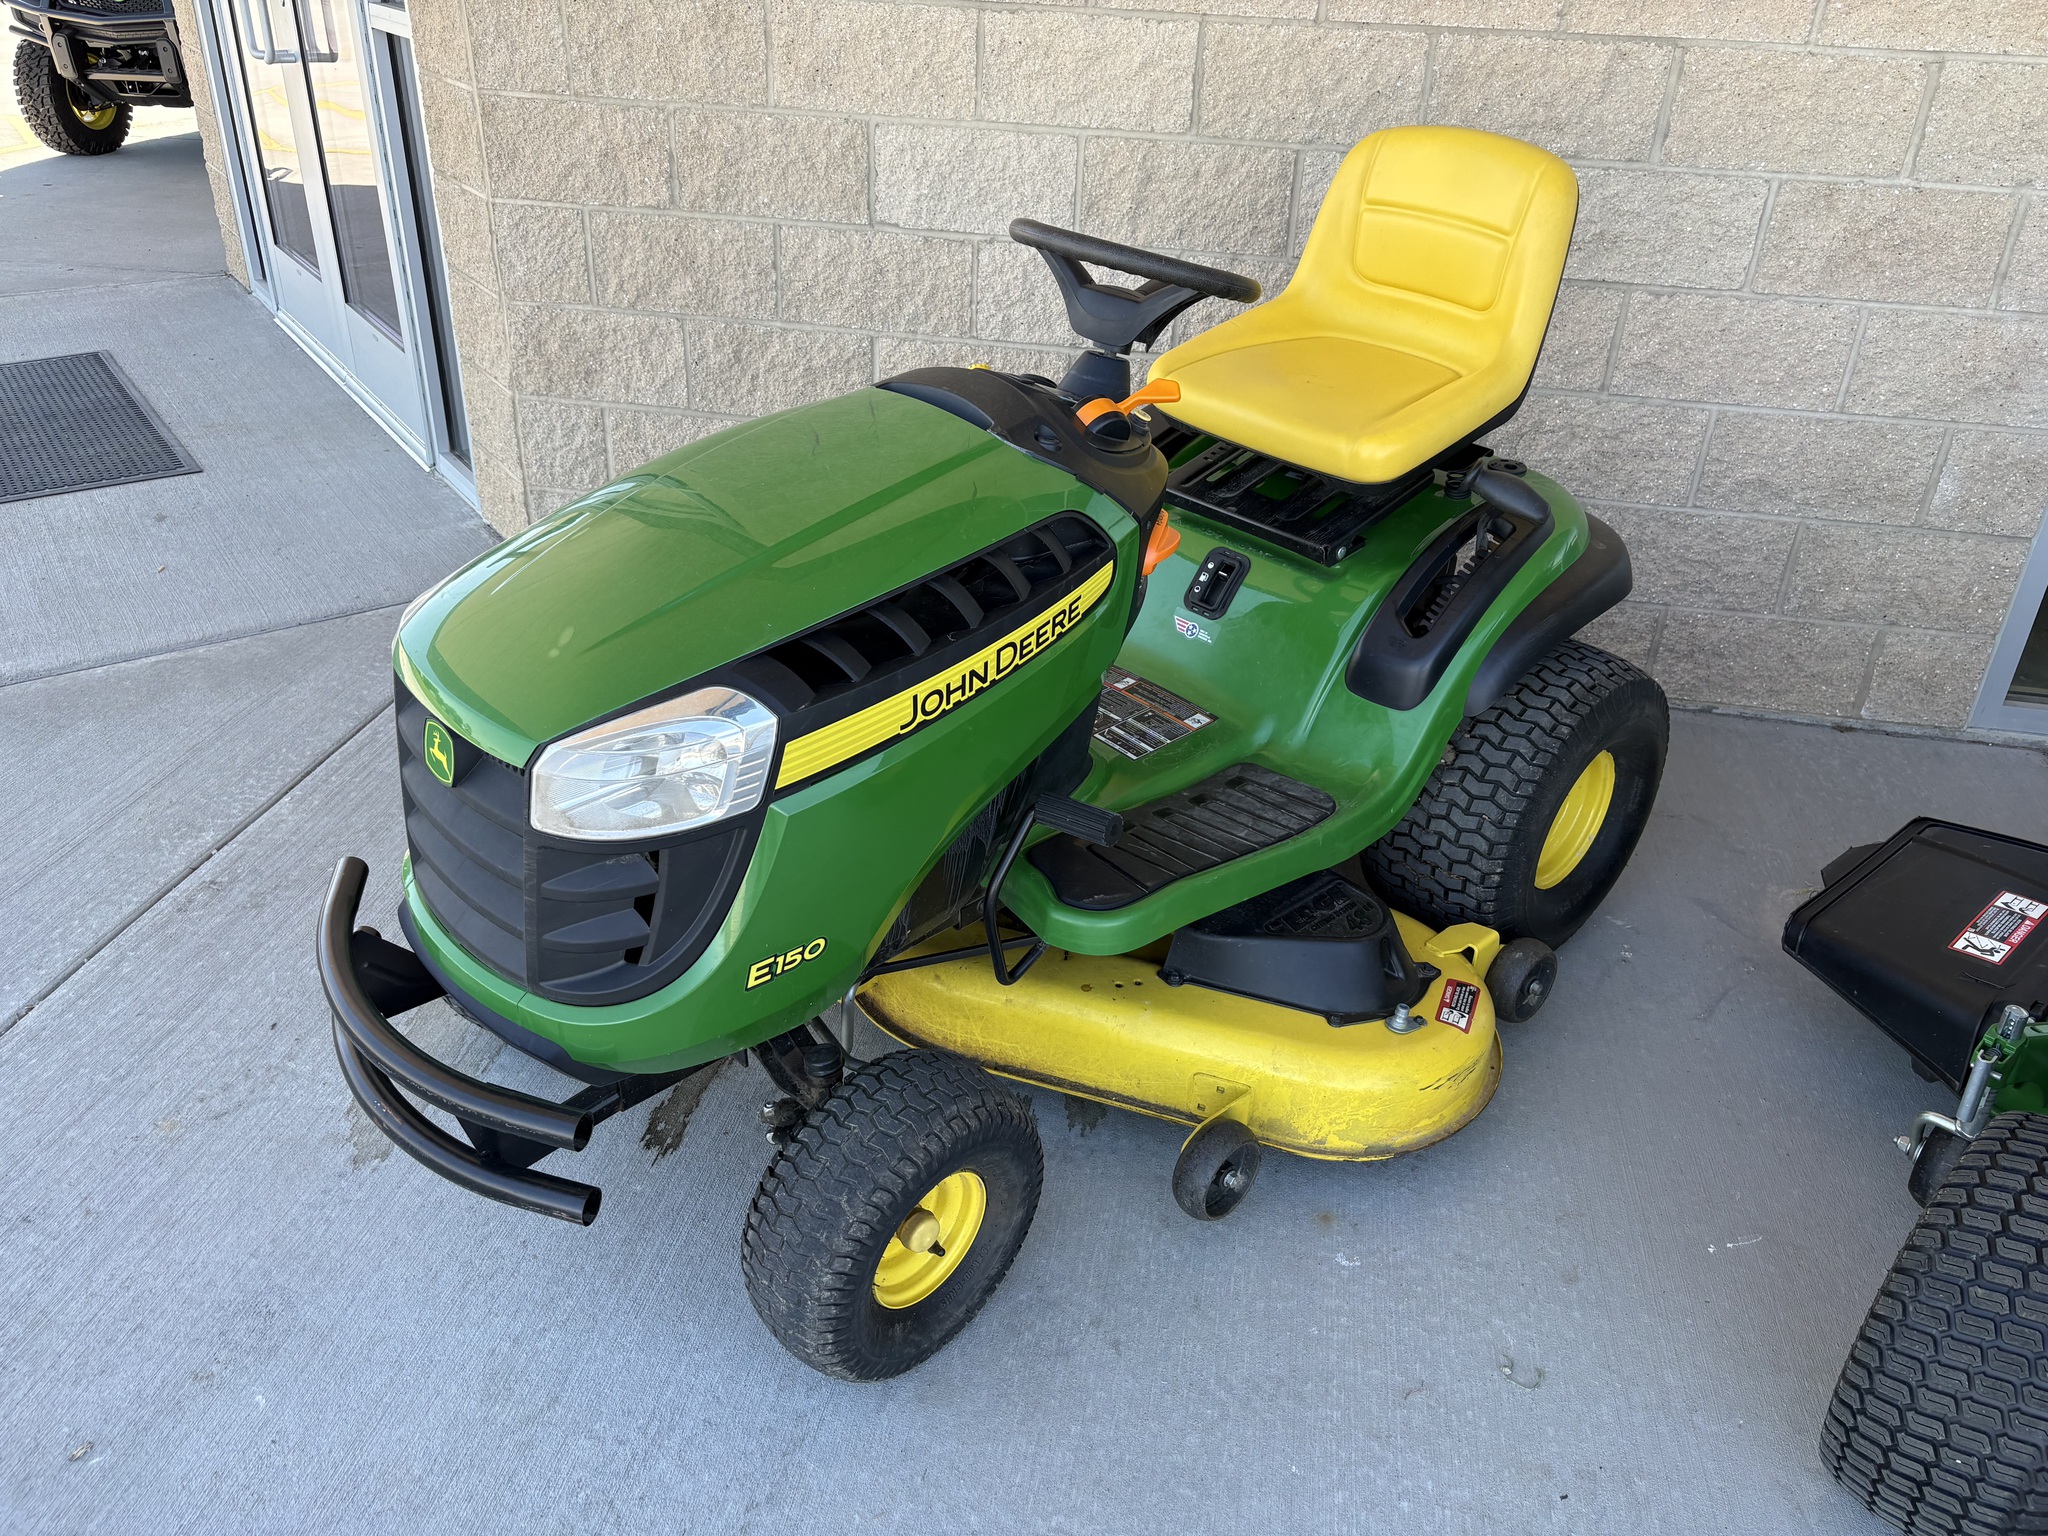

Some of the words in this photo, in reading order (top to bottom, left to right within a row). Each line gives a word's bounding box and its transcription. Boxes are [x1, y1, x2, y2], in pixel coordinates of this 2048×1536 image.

[900, 661, 989, 732] JOHN
[995, 594, 1083, 677] DEERE
[2008, 924, 2031, 944] DANGER
[746, 937, 828, 990] E150
